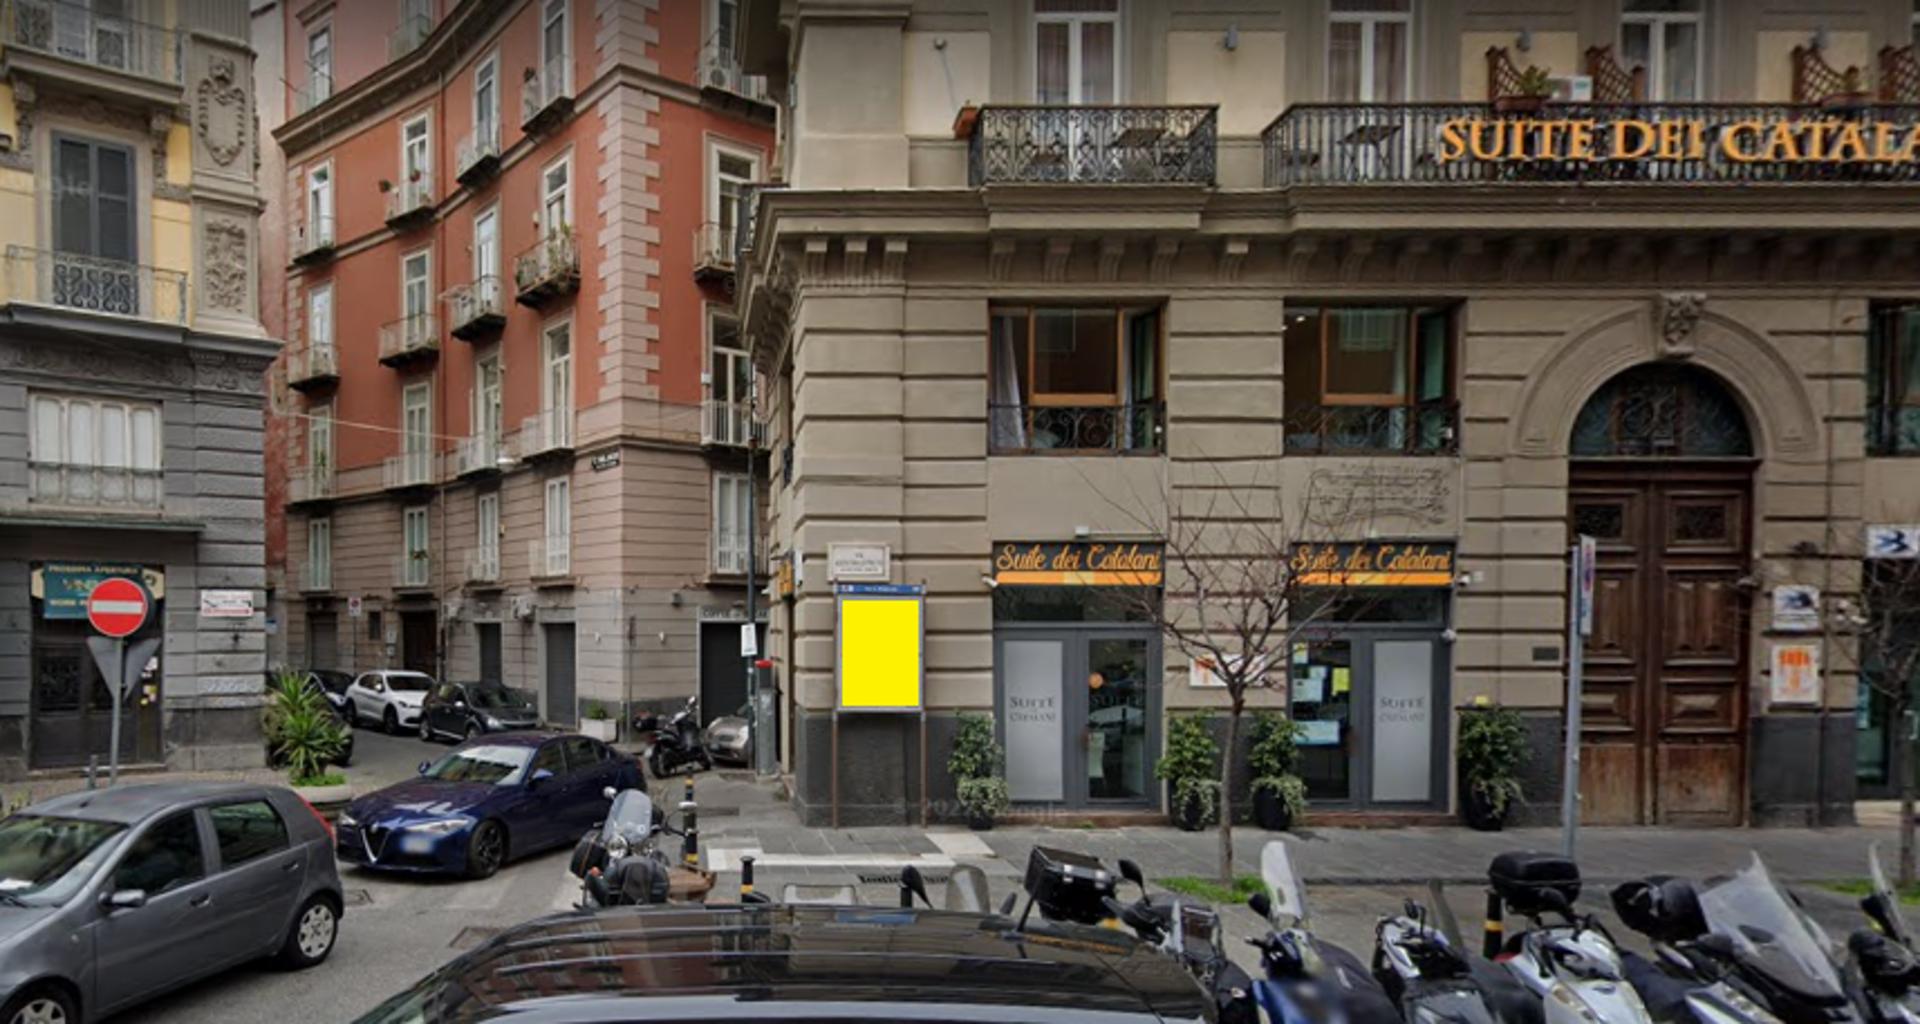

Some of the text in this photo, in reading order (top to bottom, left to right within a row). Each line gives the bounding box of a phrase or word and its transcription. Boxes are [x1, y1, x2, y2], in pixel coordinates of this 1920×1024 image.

[1437, 118, 1594, 162] SUITE
[1614, 119, 1701, 161] DEI
[996, 543, 1160, 570] Suite dei Catalani
[1289, 545, 1340, 571] Suite
[1375, 544, 1452, 570] Catalani
[1009, 696, 1056, 709] SUITE
